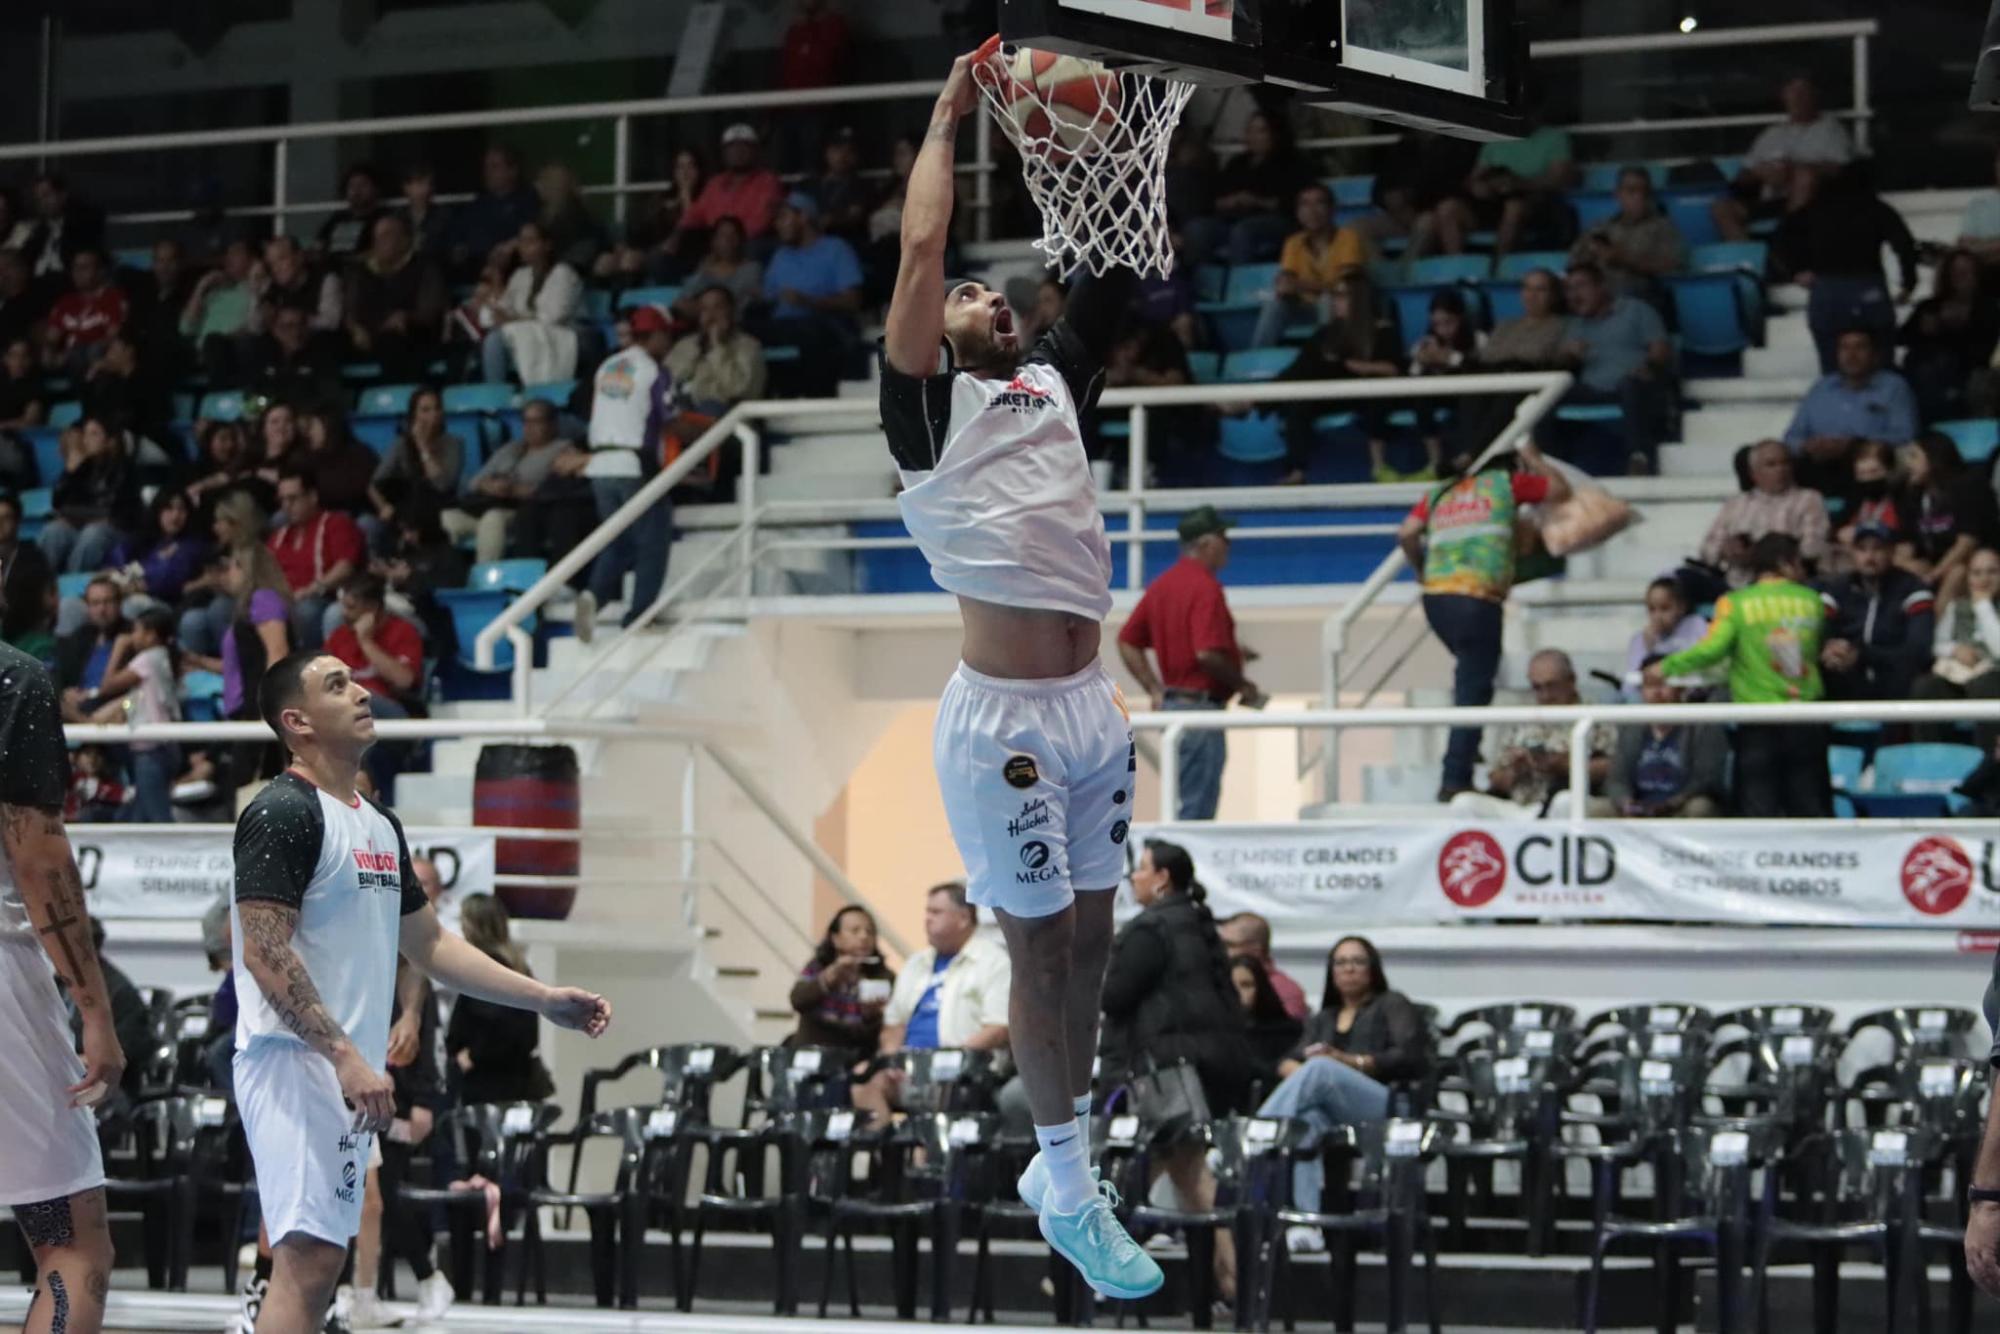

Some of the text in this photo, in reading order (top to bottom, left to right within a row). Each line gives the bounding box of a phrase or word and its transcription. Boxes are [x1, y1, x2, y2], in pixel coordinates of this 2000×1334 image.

[1302, 848, 1398, 865] GRANDES
[1515, 835, 1616, 886] CID
[1755, 851, 1860, 869] GRANDES
[1016, 865, 1060, 884] MEGA
[1314, 873, 1383, 890] LOBOS
[1768, 877, 1841, 896] LOBOS
